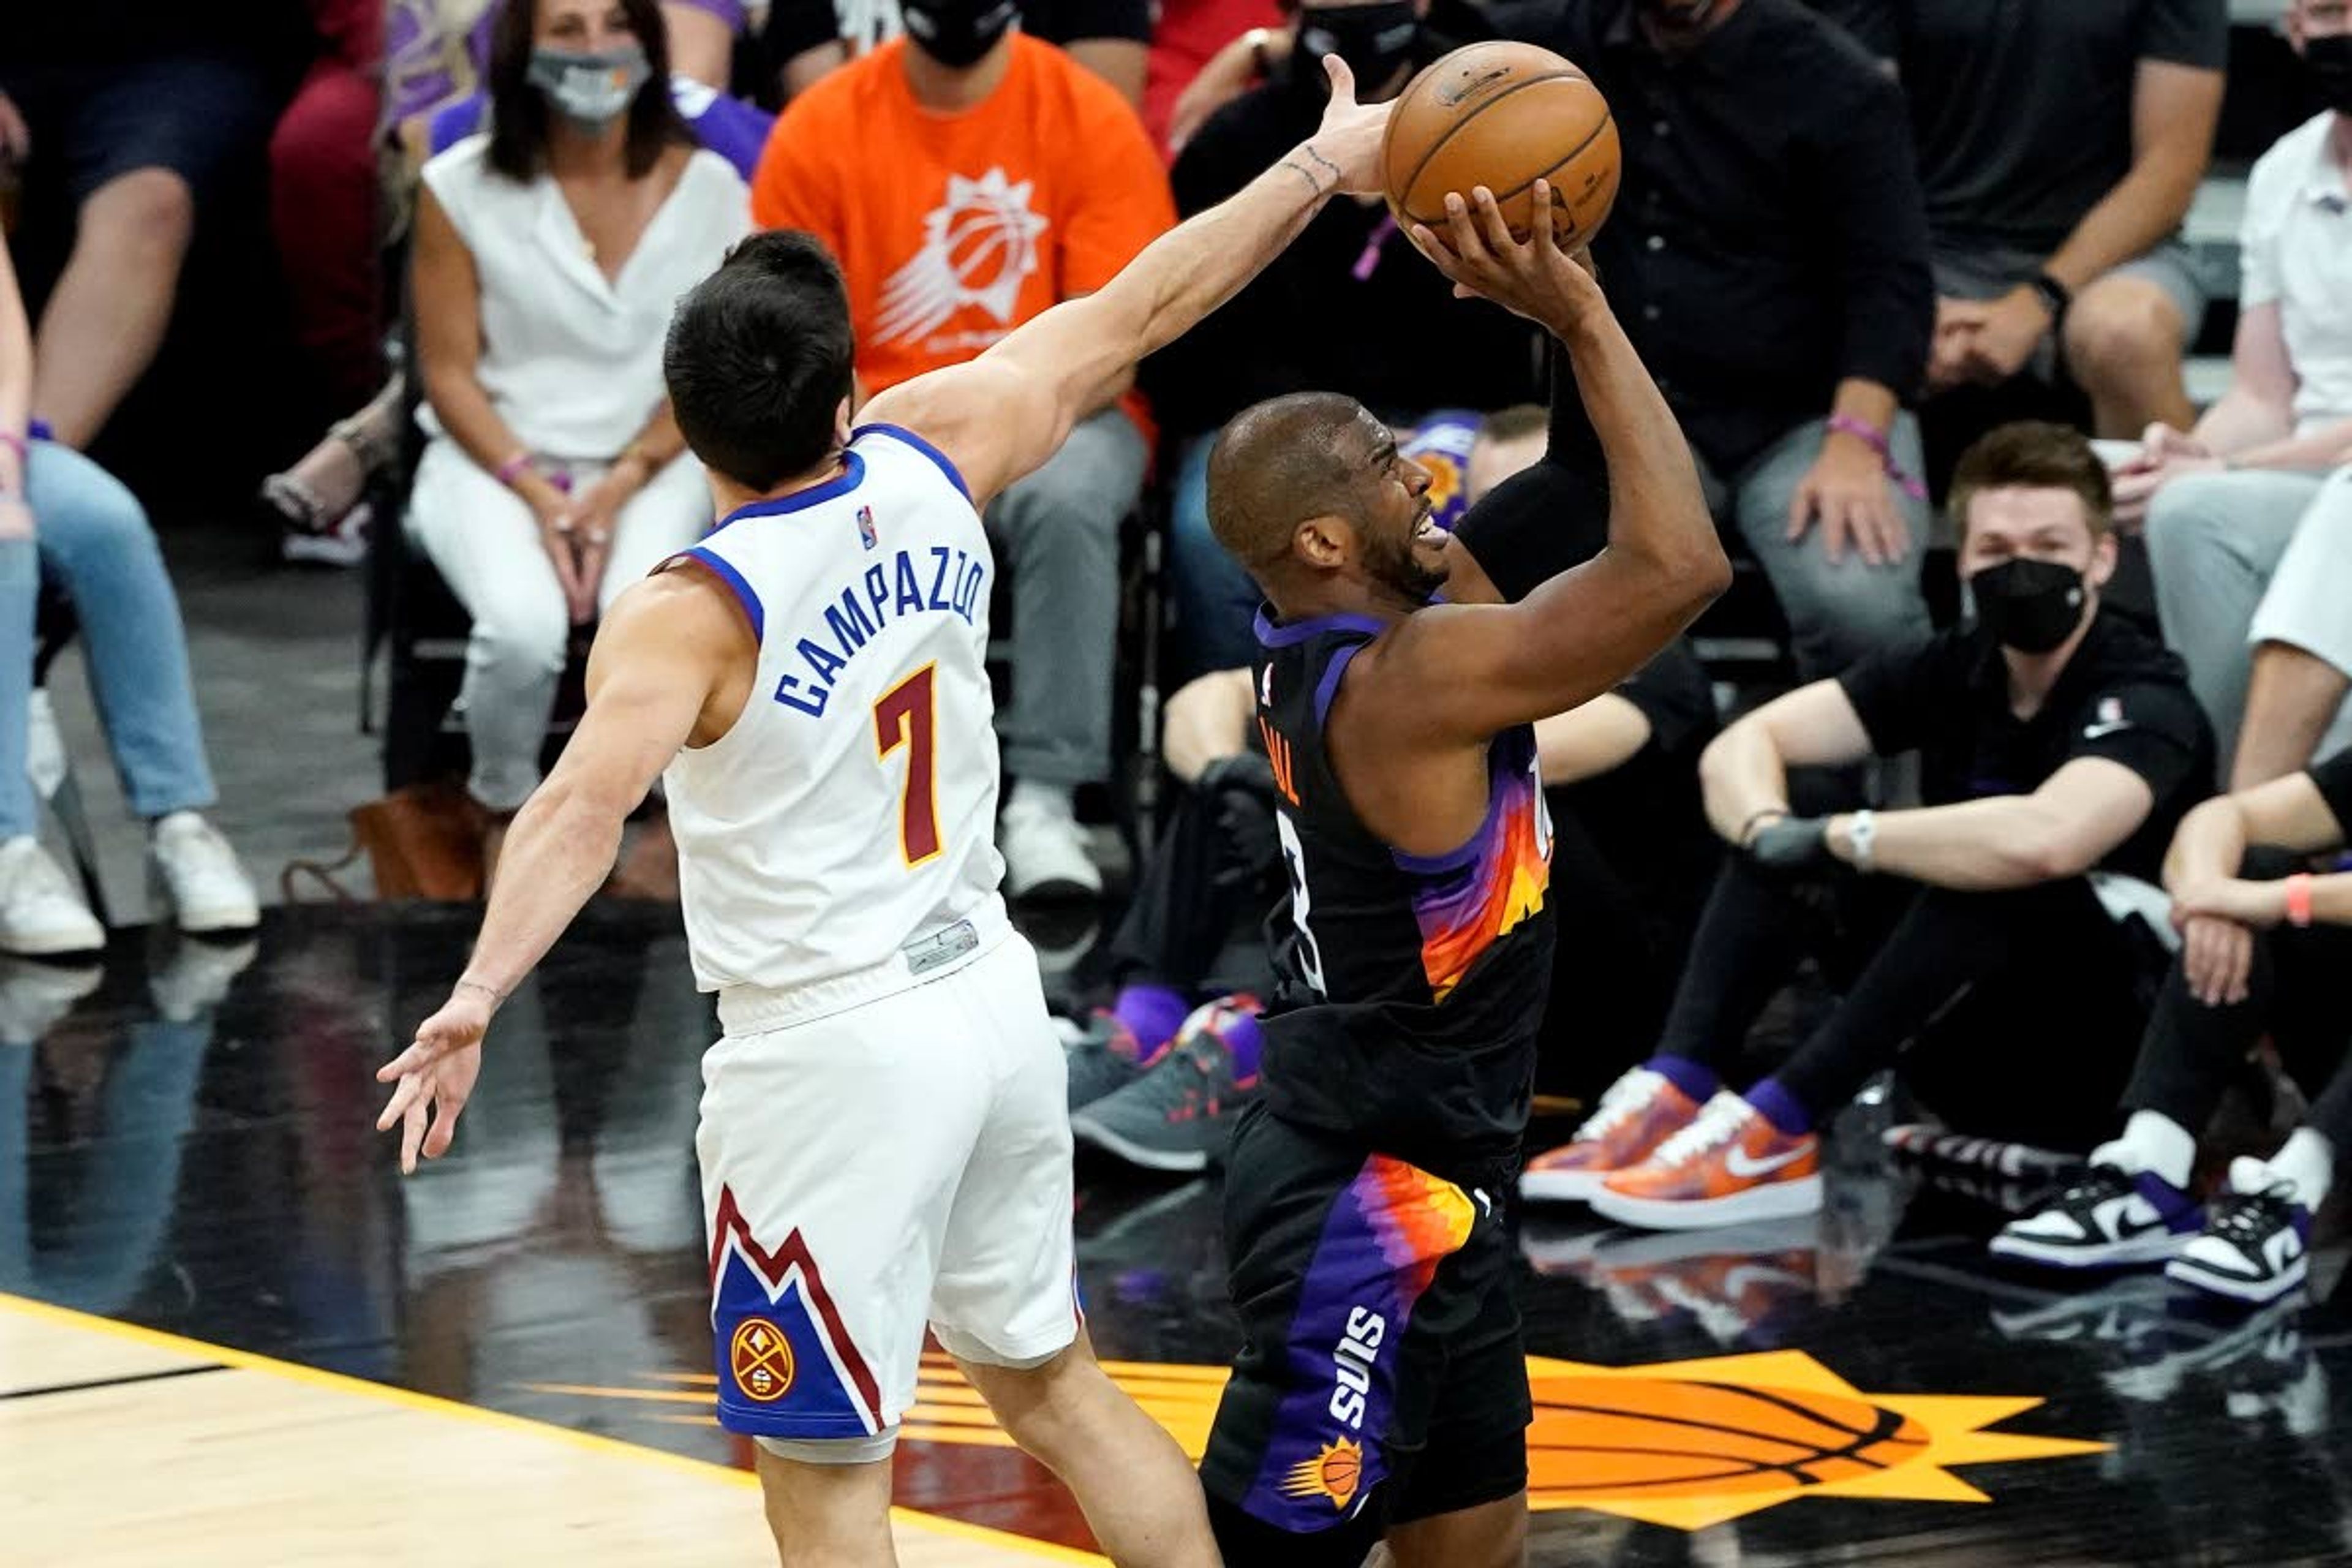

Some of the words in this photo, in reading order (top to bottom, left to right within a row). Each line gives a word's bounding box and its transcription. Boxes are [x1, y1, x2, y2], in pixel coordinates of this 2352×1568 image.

[774, 546, 984, 718] CAMPAZZO
[872, 658, 945, 872] 7
[1329, 1305, 1385, 1430] SUNS
